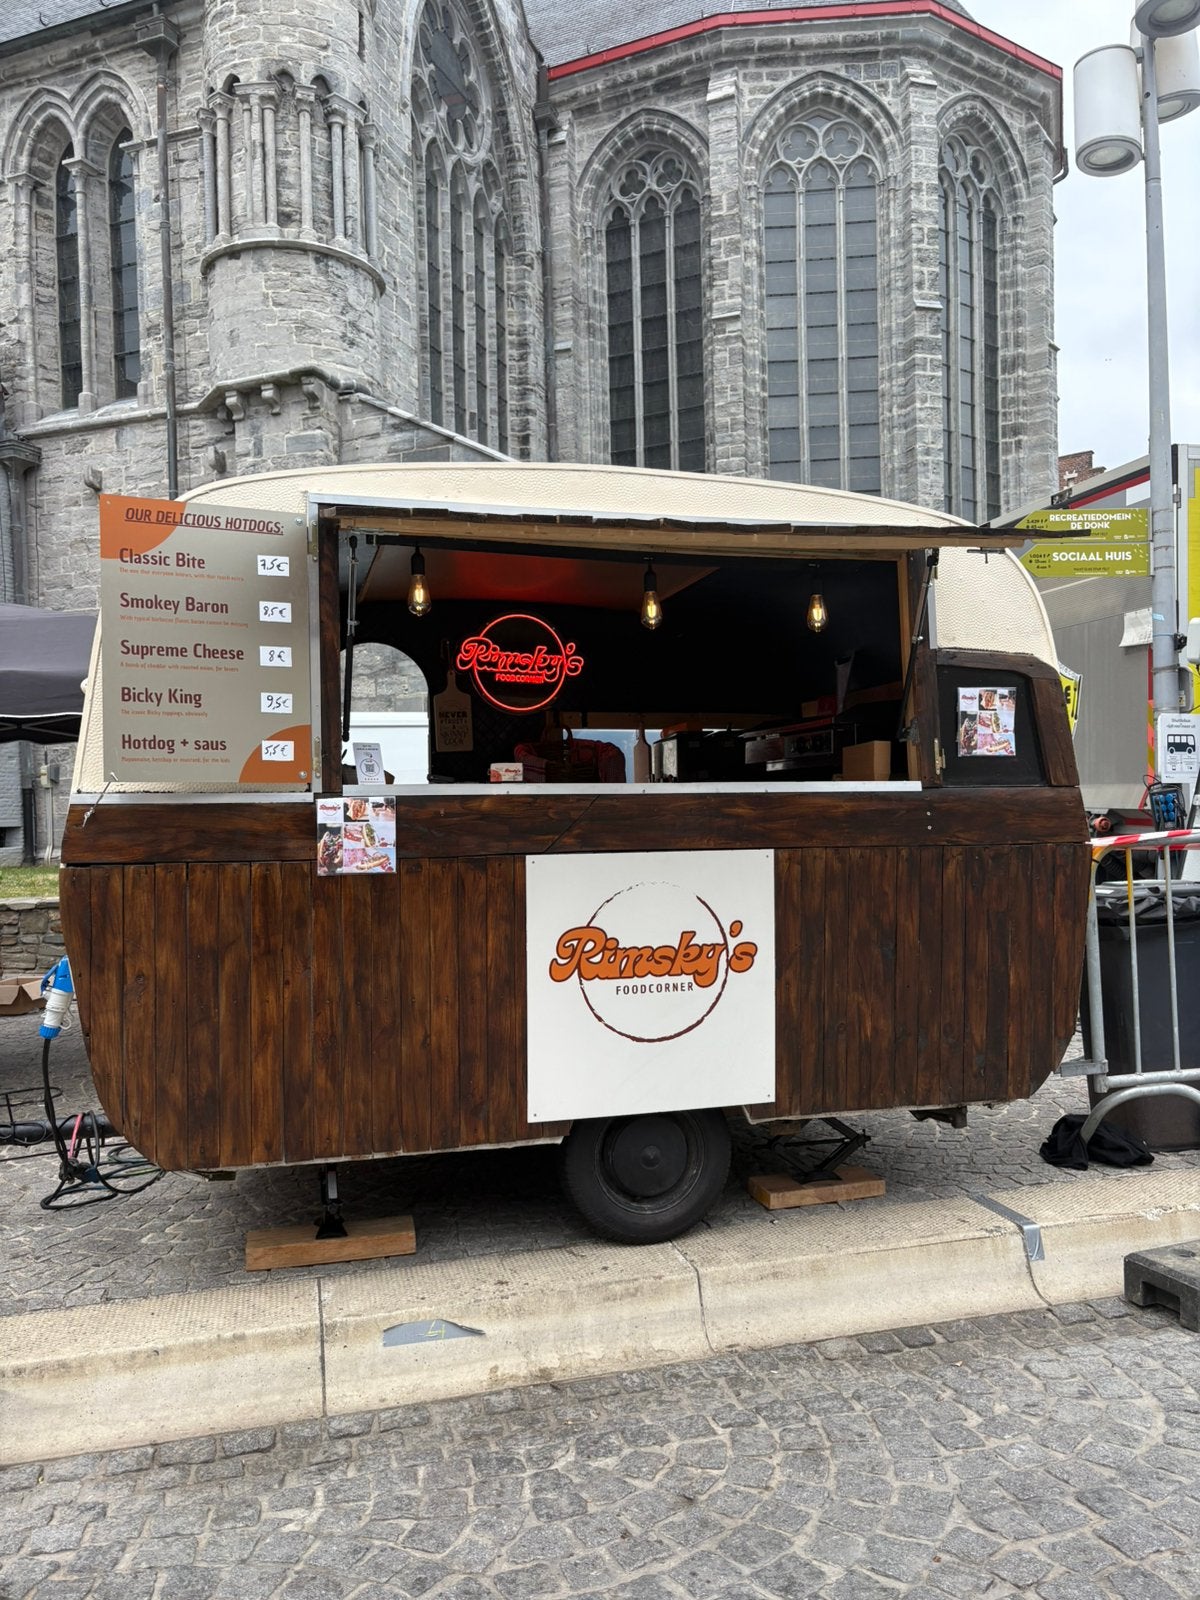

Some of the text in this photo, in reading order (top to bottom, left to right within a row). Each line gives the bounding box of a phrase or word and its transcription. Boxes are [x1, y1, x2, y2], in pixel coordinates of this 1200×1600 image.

[125, 507, 284, 535] OUR DELICIOUS HOTDOGS:
[1049, 513, 1131, 522] RECREATIEDOMEIN
[119, 548, 205, 569] Classic Bite
[1052, 552, 1132, 561] SOCIAAL HUIS
[120, 592, 229, 614] Smokey Baron
[120, 639, 244, 660] Supreme Cheese
[457, 636, 584, 682] Rimsky's
[121, 687, 202, 708] Bicky King
[122, 734, 227, 754] Hotdog + saus
[549, 919, 758, 989] Rimsky's
[616, 981, 694, 995] FOODCORNER
